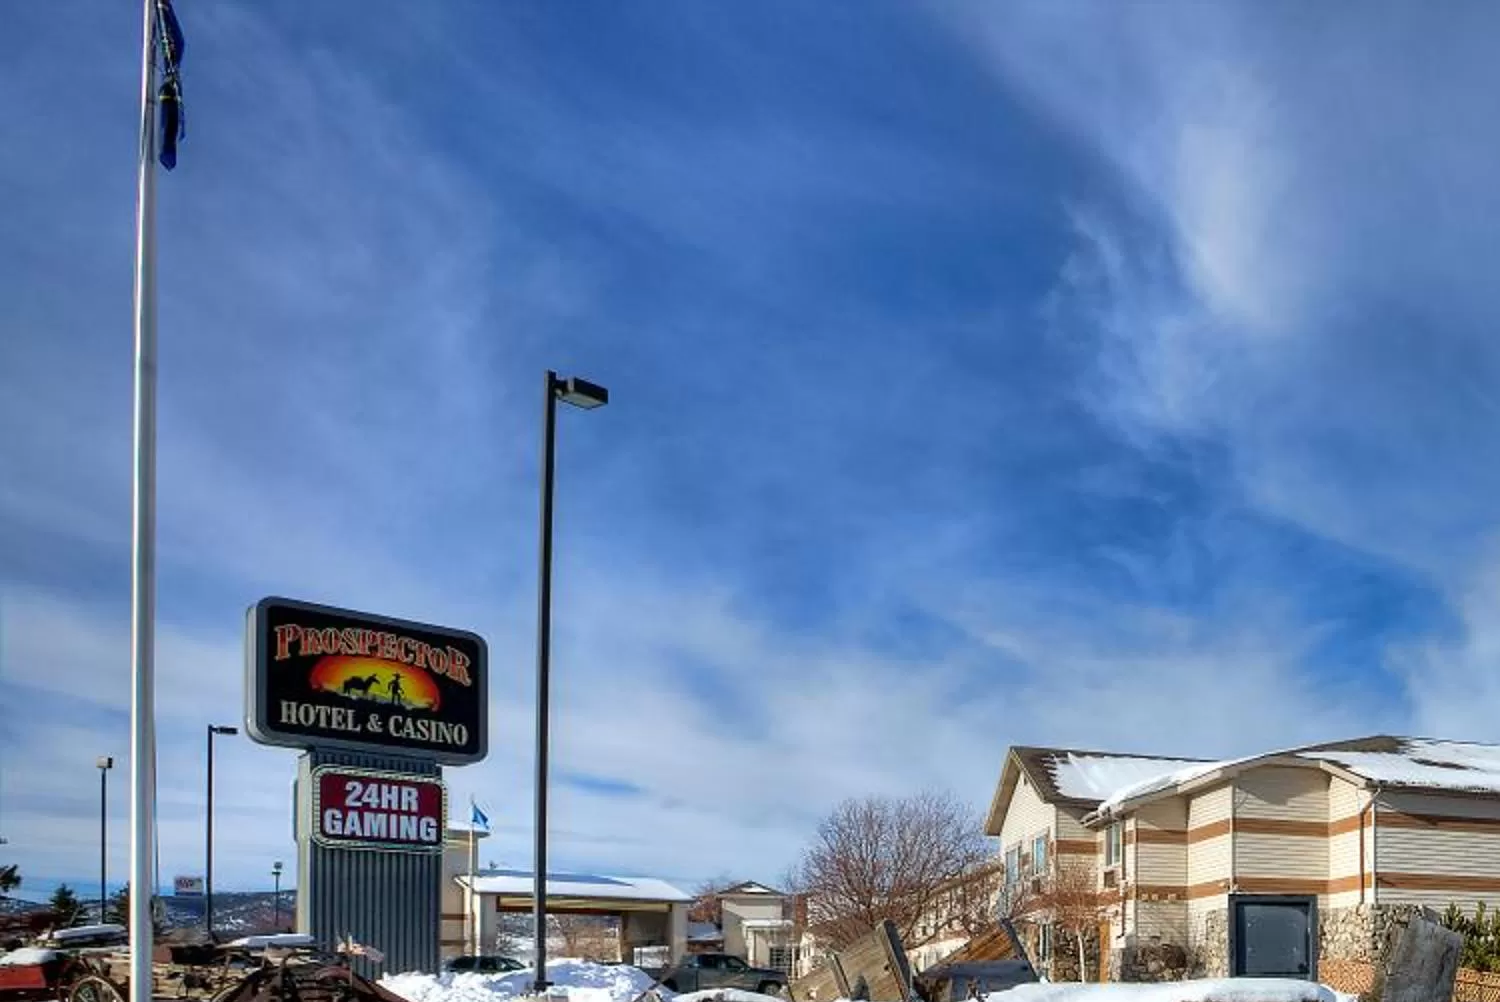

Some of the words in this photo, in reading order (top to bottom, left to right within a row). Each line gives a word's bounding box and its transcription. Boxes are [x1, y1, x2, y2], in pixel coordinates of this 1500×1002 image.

[273, 623, 473, 687] PROSPECTOR
[279, 700, 361, 732] HOTEL
[367, 713, 383, 733] &
[388, 715, 470, 746] CASINO
[345, 781, 418, 812] 24HR
[323, 808, 438, 841] GAMING
